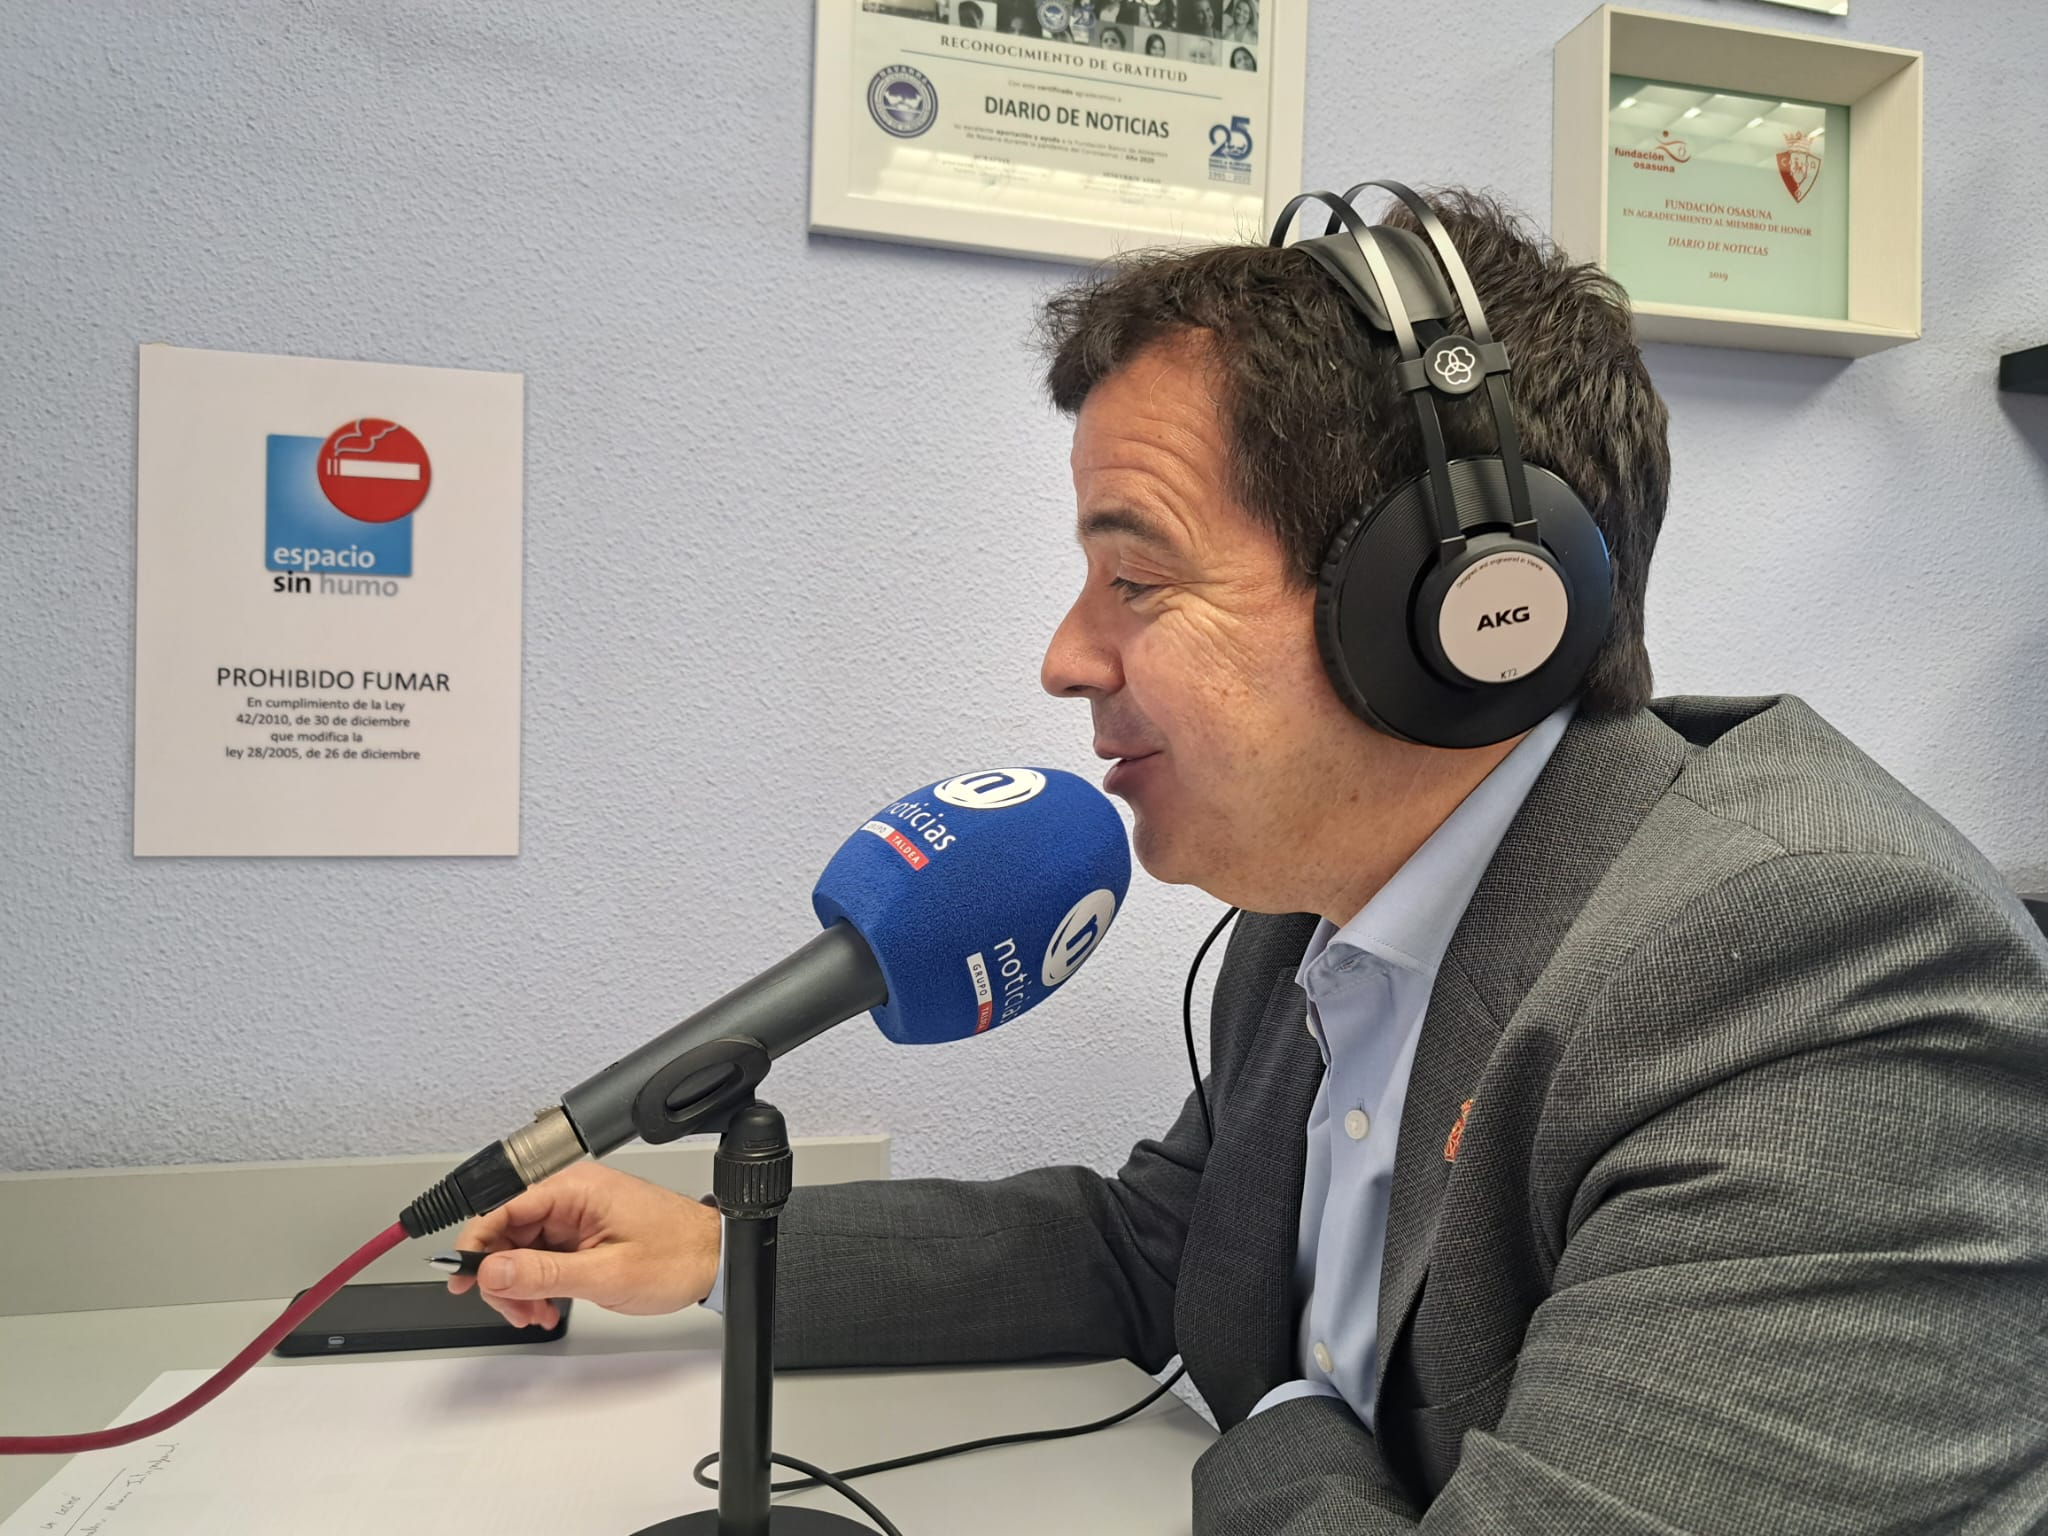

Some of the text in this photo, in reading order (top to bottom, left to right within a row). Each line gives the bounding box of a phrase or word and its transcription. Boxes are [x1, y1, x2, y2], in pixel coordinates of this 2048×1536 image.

[940, 35, 1188, 83] RECONOCIMIENTO DE GRATITUD
[984, 95, 1170, 138] DIARIO DE NOTICIAS
[1209, 115, 1253, 160] 25
[1614, 147, 1665, 161] fundación
[1633, 161, 1675, 173] osasuna
[1664, 198, 1773, 221] FUNDACIÓN OSASUNA
[1623, 208, 1813, 237] EN AGRADECIMIENTO AL MIEMBRO DE HONOR
[1668, 237, 1769, 257] DIARIO DE NOTICIAS
[1708, 272, 1729, 282] 2019
[273, 544, 376, 572] espacio
[273, 570, 399, 597] sin humo
[1477, 606, 1530, 632] AKG
[217, 667, 451, 692] PROHIBIDO FUMAR
[1501, 668, 1518, 680] K72
[247, 697, 406, 713] En cumplimiento de la Ley
[236, 714, 410, 728] 42/2010, de 30 de diciembre
[270, 731, 363, 744] que modifica la
[225, 747, 421, 761] ley 28/2005, de 26 de diciembre
[960, 772, 1015, 794] n
[892, 835, 921, 864] TALDEA
[1066, 913, 1098, 968] n
[972, 963, 988, 996] GRUPO
